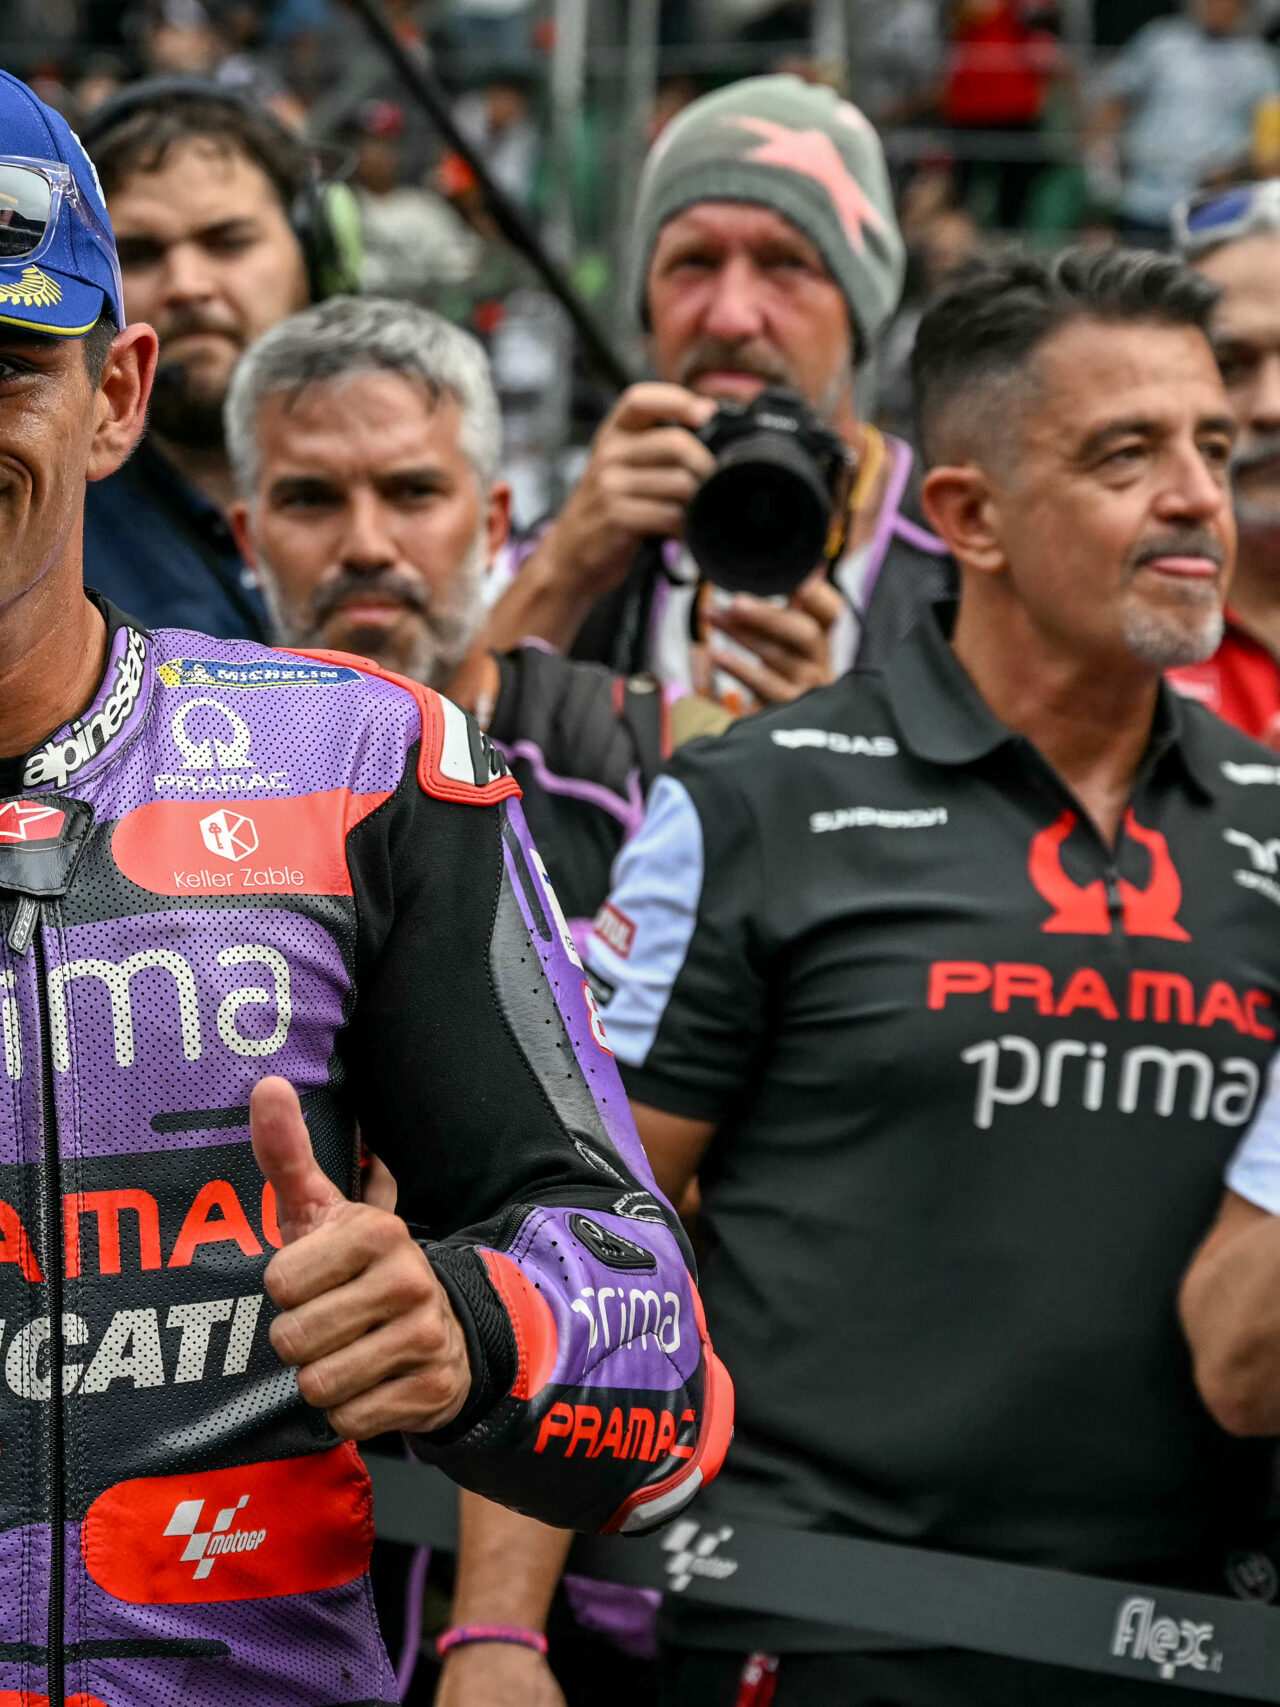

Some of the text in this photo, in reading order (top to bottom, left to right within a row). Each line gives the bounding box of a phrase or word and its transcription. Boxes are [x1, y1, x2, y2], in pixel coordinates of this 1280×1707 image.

[217, 669, 338, 682] MICHELIN
[153, 772, 291, 793] PRAMAC
[173, 866, 304, 888] Keller Zable
[927, 960, 1277, 1042] PRAMAC
[961, 1034, 1261, 1130] prima
